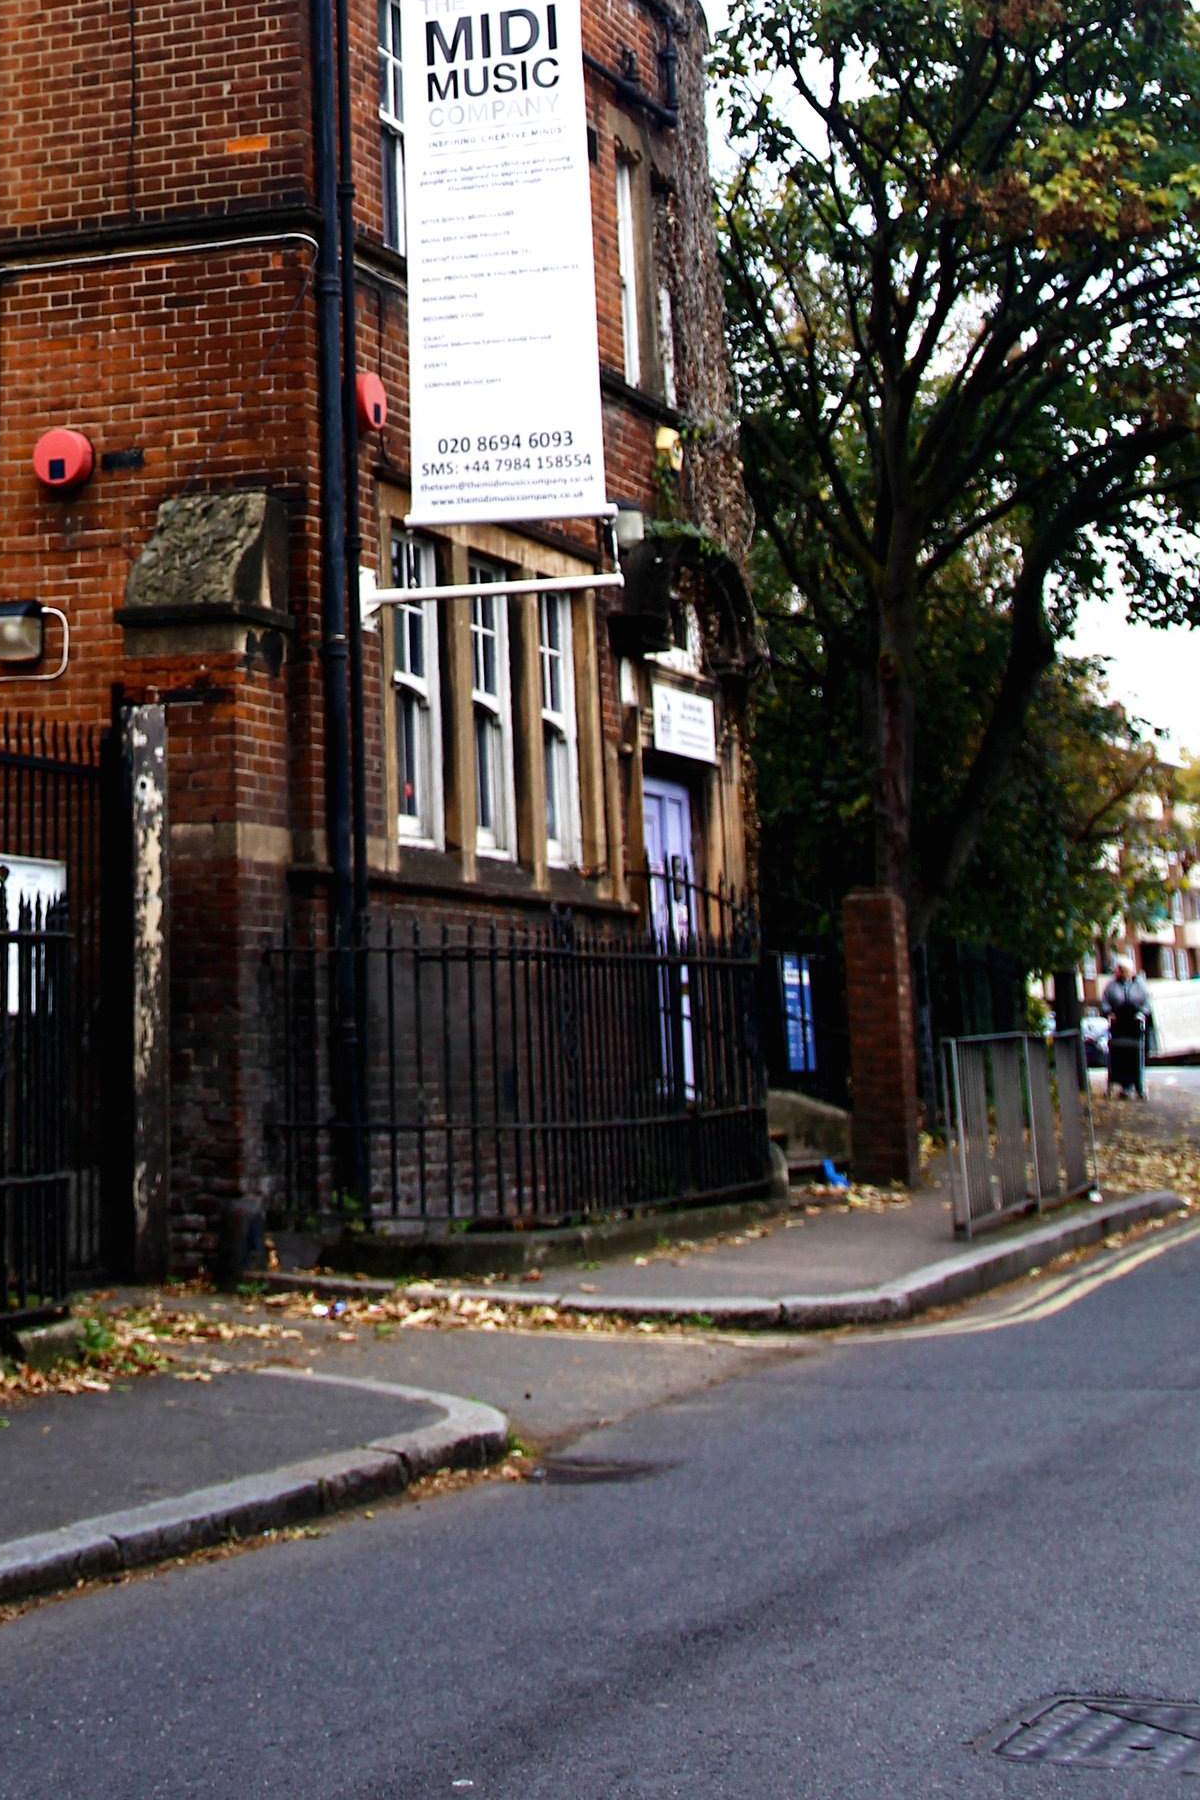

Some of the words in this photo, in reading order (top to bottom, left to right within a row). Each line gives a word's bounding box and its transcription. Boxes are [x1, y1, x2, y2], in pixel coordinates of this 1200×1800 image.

[425, 3, 557, 66] MIDI
[427, 57, 559, 102] MUSIC
[429, 93, 559, 127] COMPANY
[429, 136, 476, 148] INSPIRING
[481, 131, 526, 143] CREATIVE
[438, 437, 470, 454] 020
[477, 434, 521, 451] 8694
[529, 431, 573, 448] 6093
[422, 461, 460, 476] SMS:
[464, 460, 490, 472] +44
[495, 457, 531, 471] 7984
[537, 453, 592, 470] 158554
[431, 490, 584, 505] www.themidimusiccompany.co.uk
